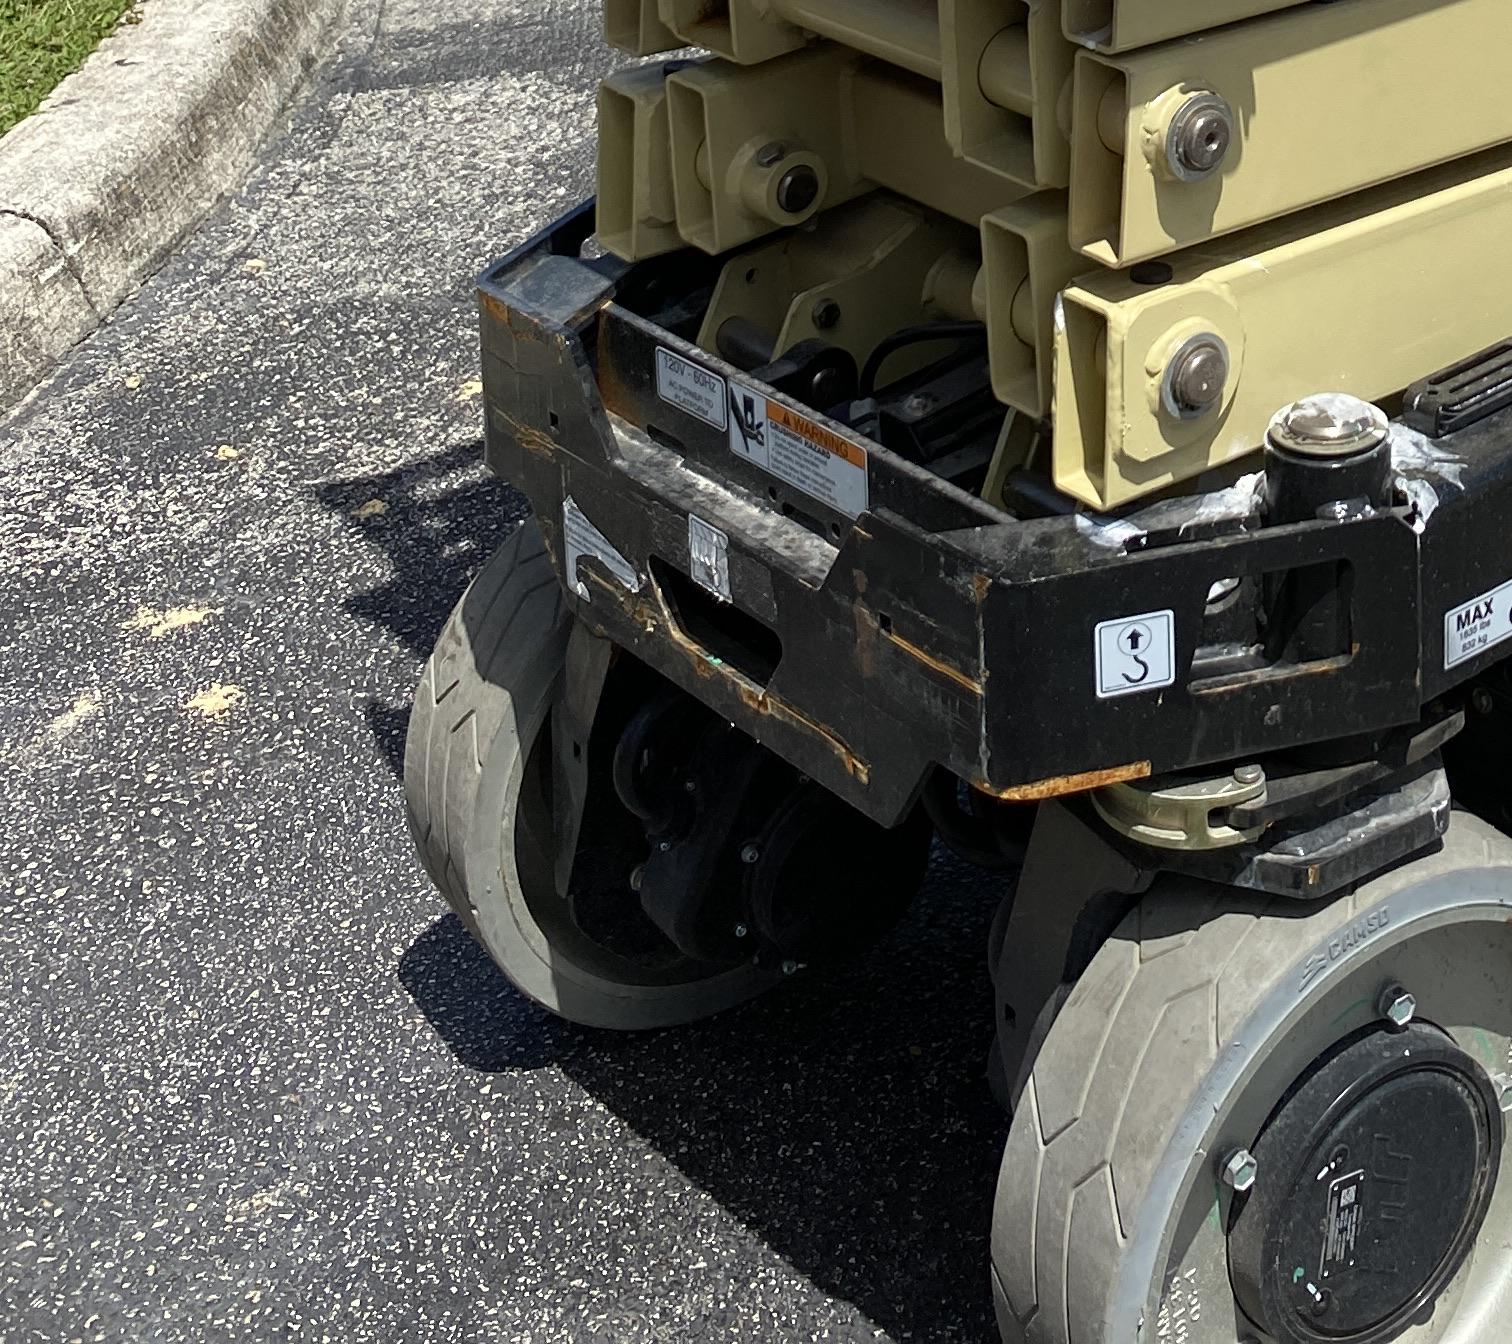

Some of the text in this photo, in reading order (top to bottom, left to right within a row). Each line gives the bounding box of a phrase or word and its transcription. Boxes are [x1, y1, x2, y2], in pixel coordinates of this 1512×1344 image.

[793, 415, 849, 459] WARNING
[1456, 597, 1494, 632] MAX
[1328, 904, 1389, 961] CAMSO
